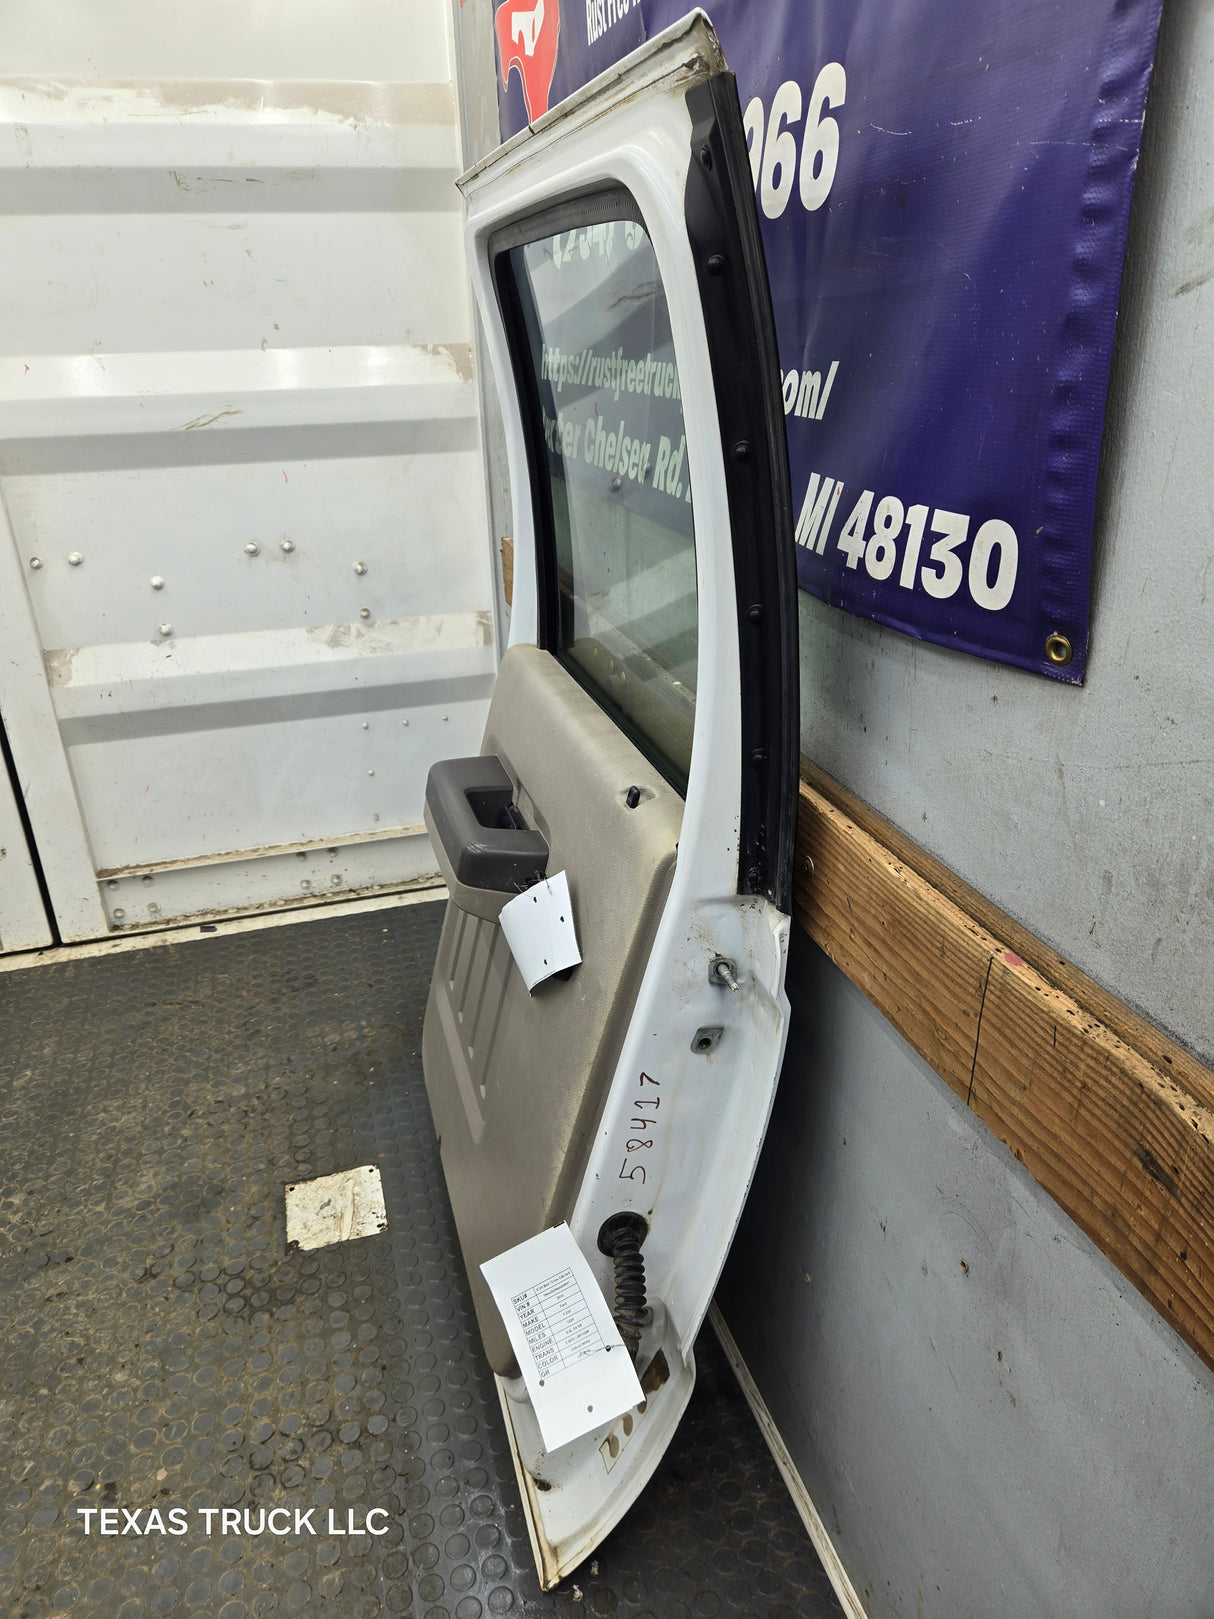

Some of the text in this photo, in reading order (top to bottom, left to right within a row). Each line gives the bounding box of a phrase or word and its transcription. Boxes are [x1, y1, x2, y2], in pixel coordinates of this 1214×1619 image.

[780, 361, 840, 420] om/
[653, 435, 685, 499] Rd.
[794, 472, 845, 555] MI
[837, 489, 1018, 611] 48130
[619, 1071, 660, 1184] 58417
[520, 1308, 536, 1320] YEAR
[522, 1316, 539, 1328] MAKE
[525, 1323, 546, 1335] MODEL
[528, 1332, 546, 1344] MILES
[531, 1338, 553, 1352] ENGINE
[535, 1347, 555, 1360] TRANS
[538, 1355, 559, 1369] COLOR
